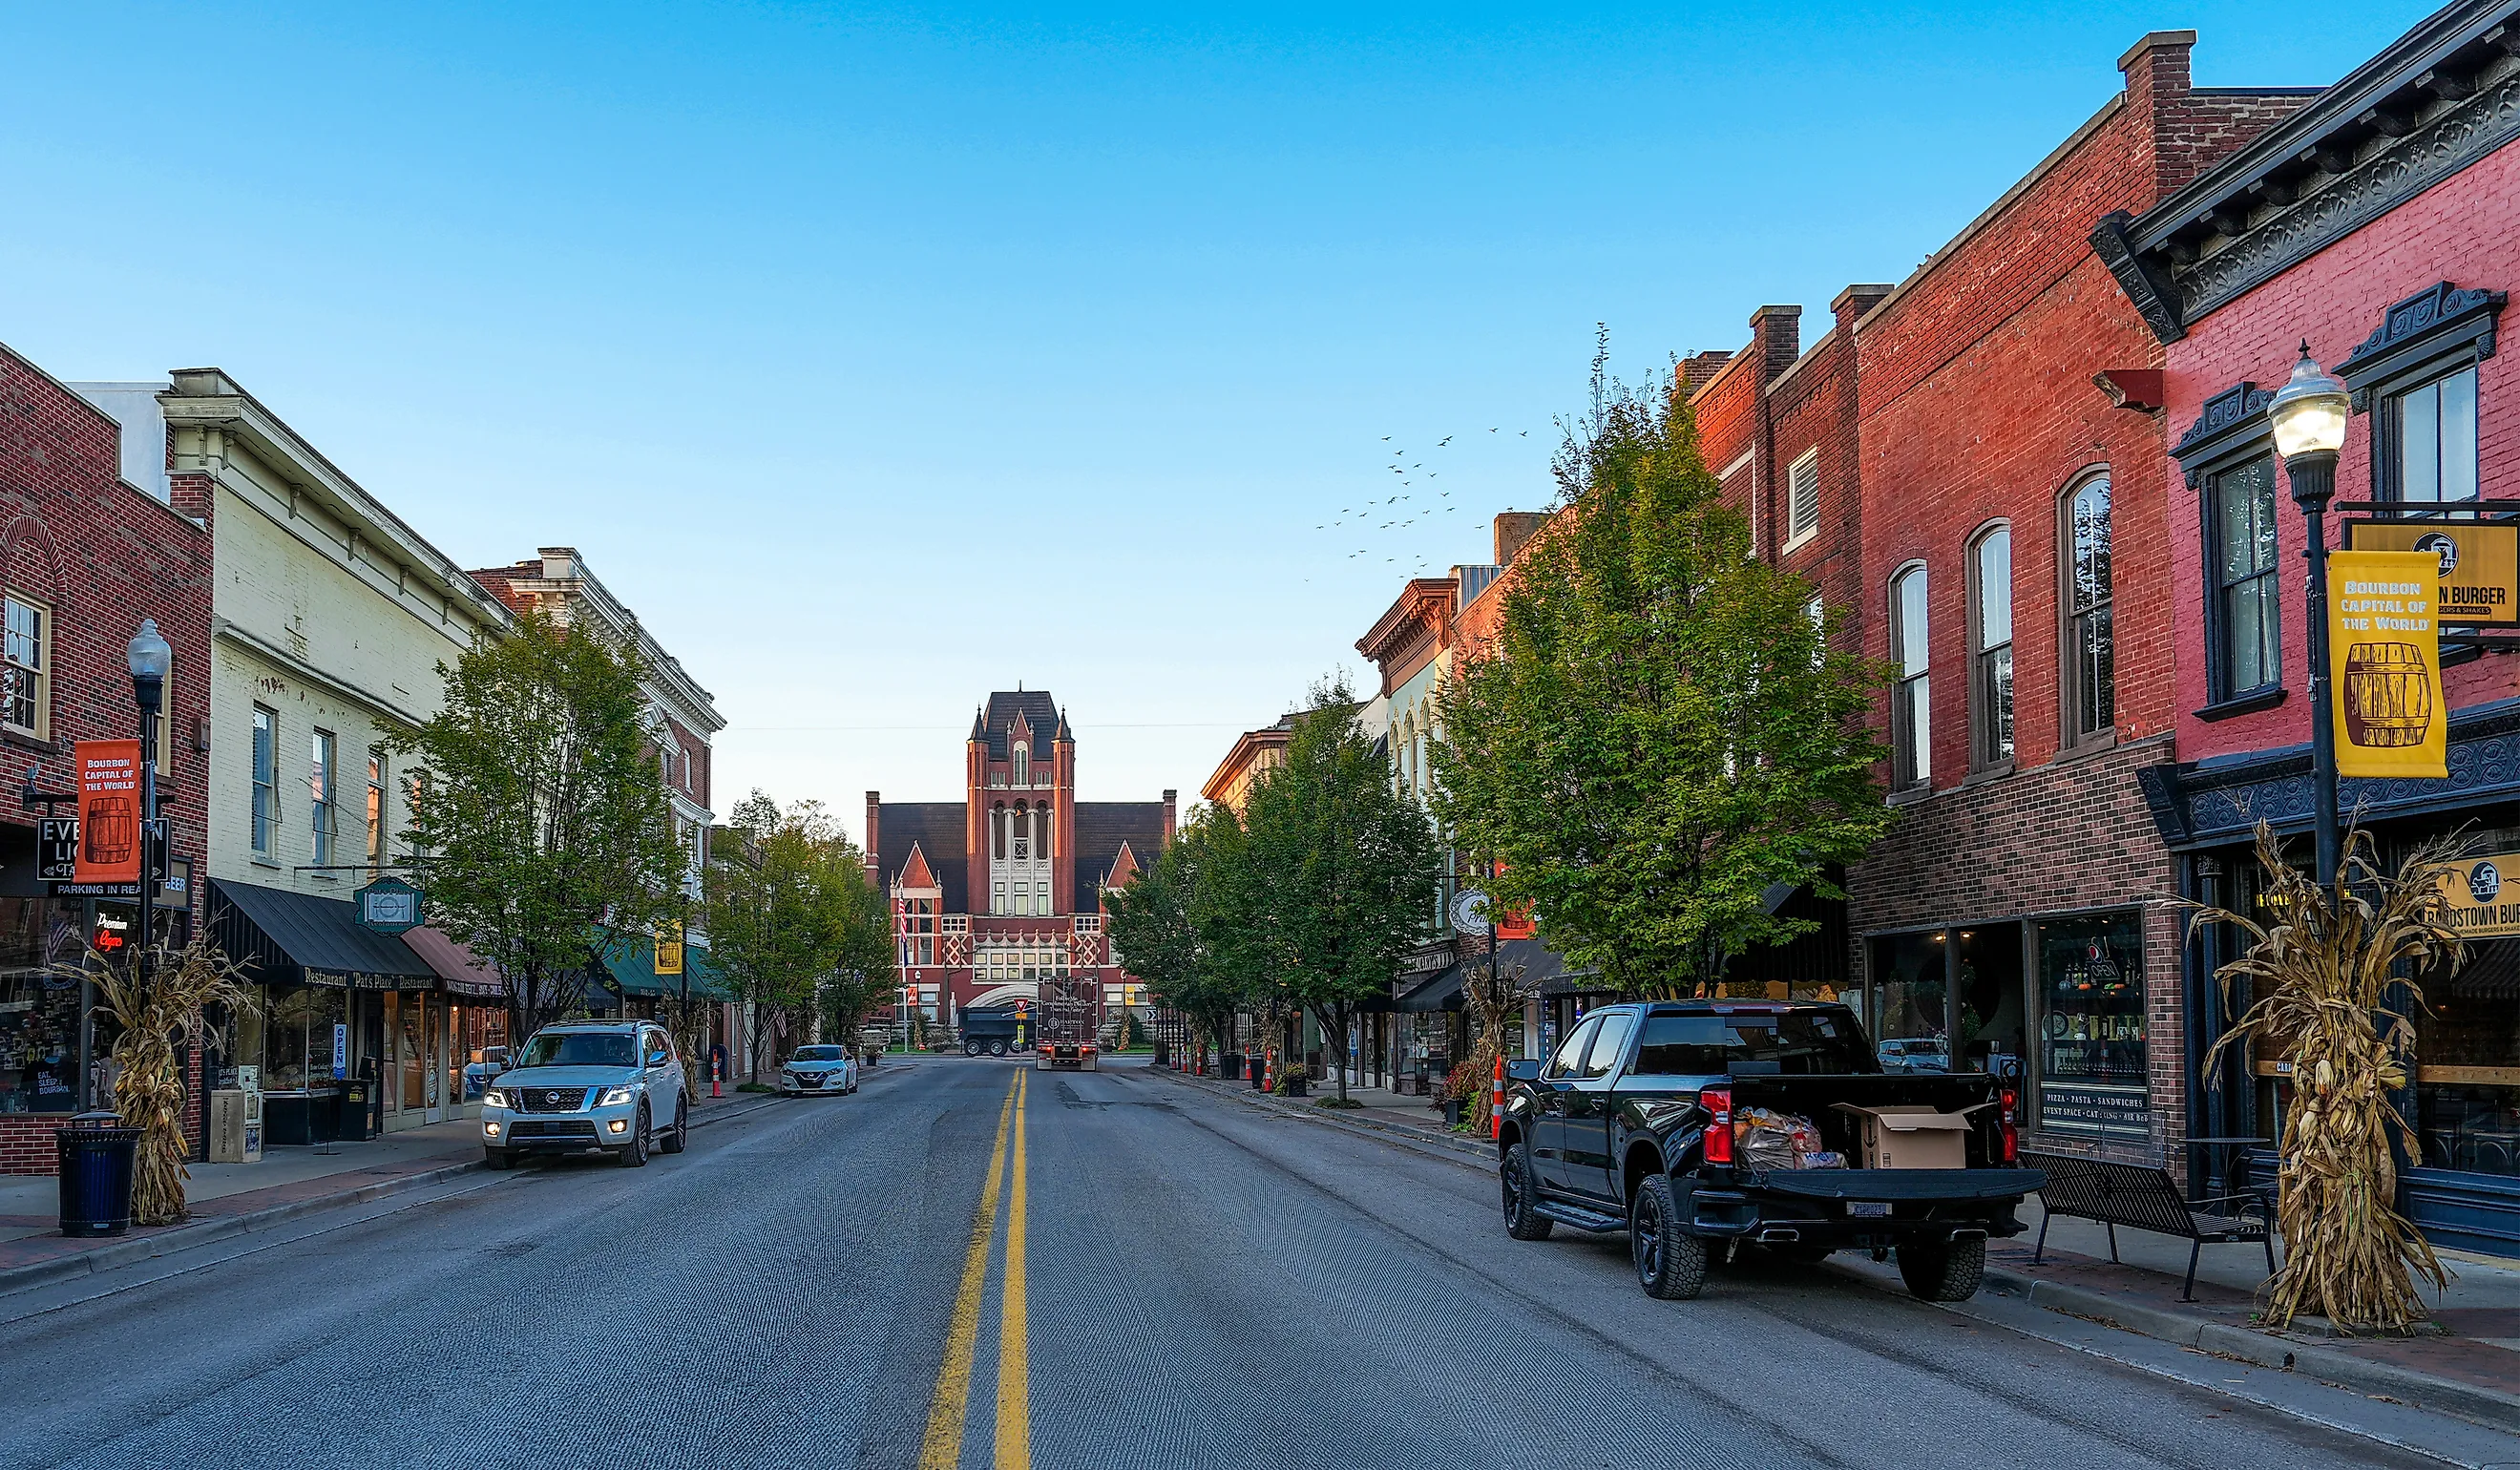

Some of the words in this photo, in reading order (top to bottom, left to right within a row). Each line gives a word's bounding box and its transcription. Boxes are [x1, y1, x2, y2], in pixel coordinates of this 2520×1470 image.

[2344, 580, 2421, 596] BOURBON
[2451, 586, 2506, 604] BURGER
[2341, 598, 2404, 613] CAPITAL
[2407, 600, 2426, 613] OF
[2342, 618, 2369, 630] THE
[2374, 617, 2429, 631] WORLD
[87, 758, 131, 768] BOURBON
[84, 771, 121, 780] CAPITAL
[121, 769, 135, 779] OF
[85, 783, 102, 791] THE
[103, 781, 135, 790] WORLD
[57, 885, 103, 895] PARKING
[107, 885, 117, 894] IN
[121, 884, 141, 894] REA
[2090, 964, 2116, 976] OPEN
[304, 966, 347, 987] Restaurant
[398, 975, 433, 989] Restaurant
[336, 1027, 345, 1063] OPEN
[2047, 1093, 2066, 1102] PIZZA
[2070, 1095, 2091, 1104] PASTA
[2097, 1097, 2143, 1107] SANDWICHES
[2043, 1106, 2063, 1115] EVENT
[2063, 1107, 2082, 1117] SPACE
